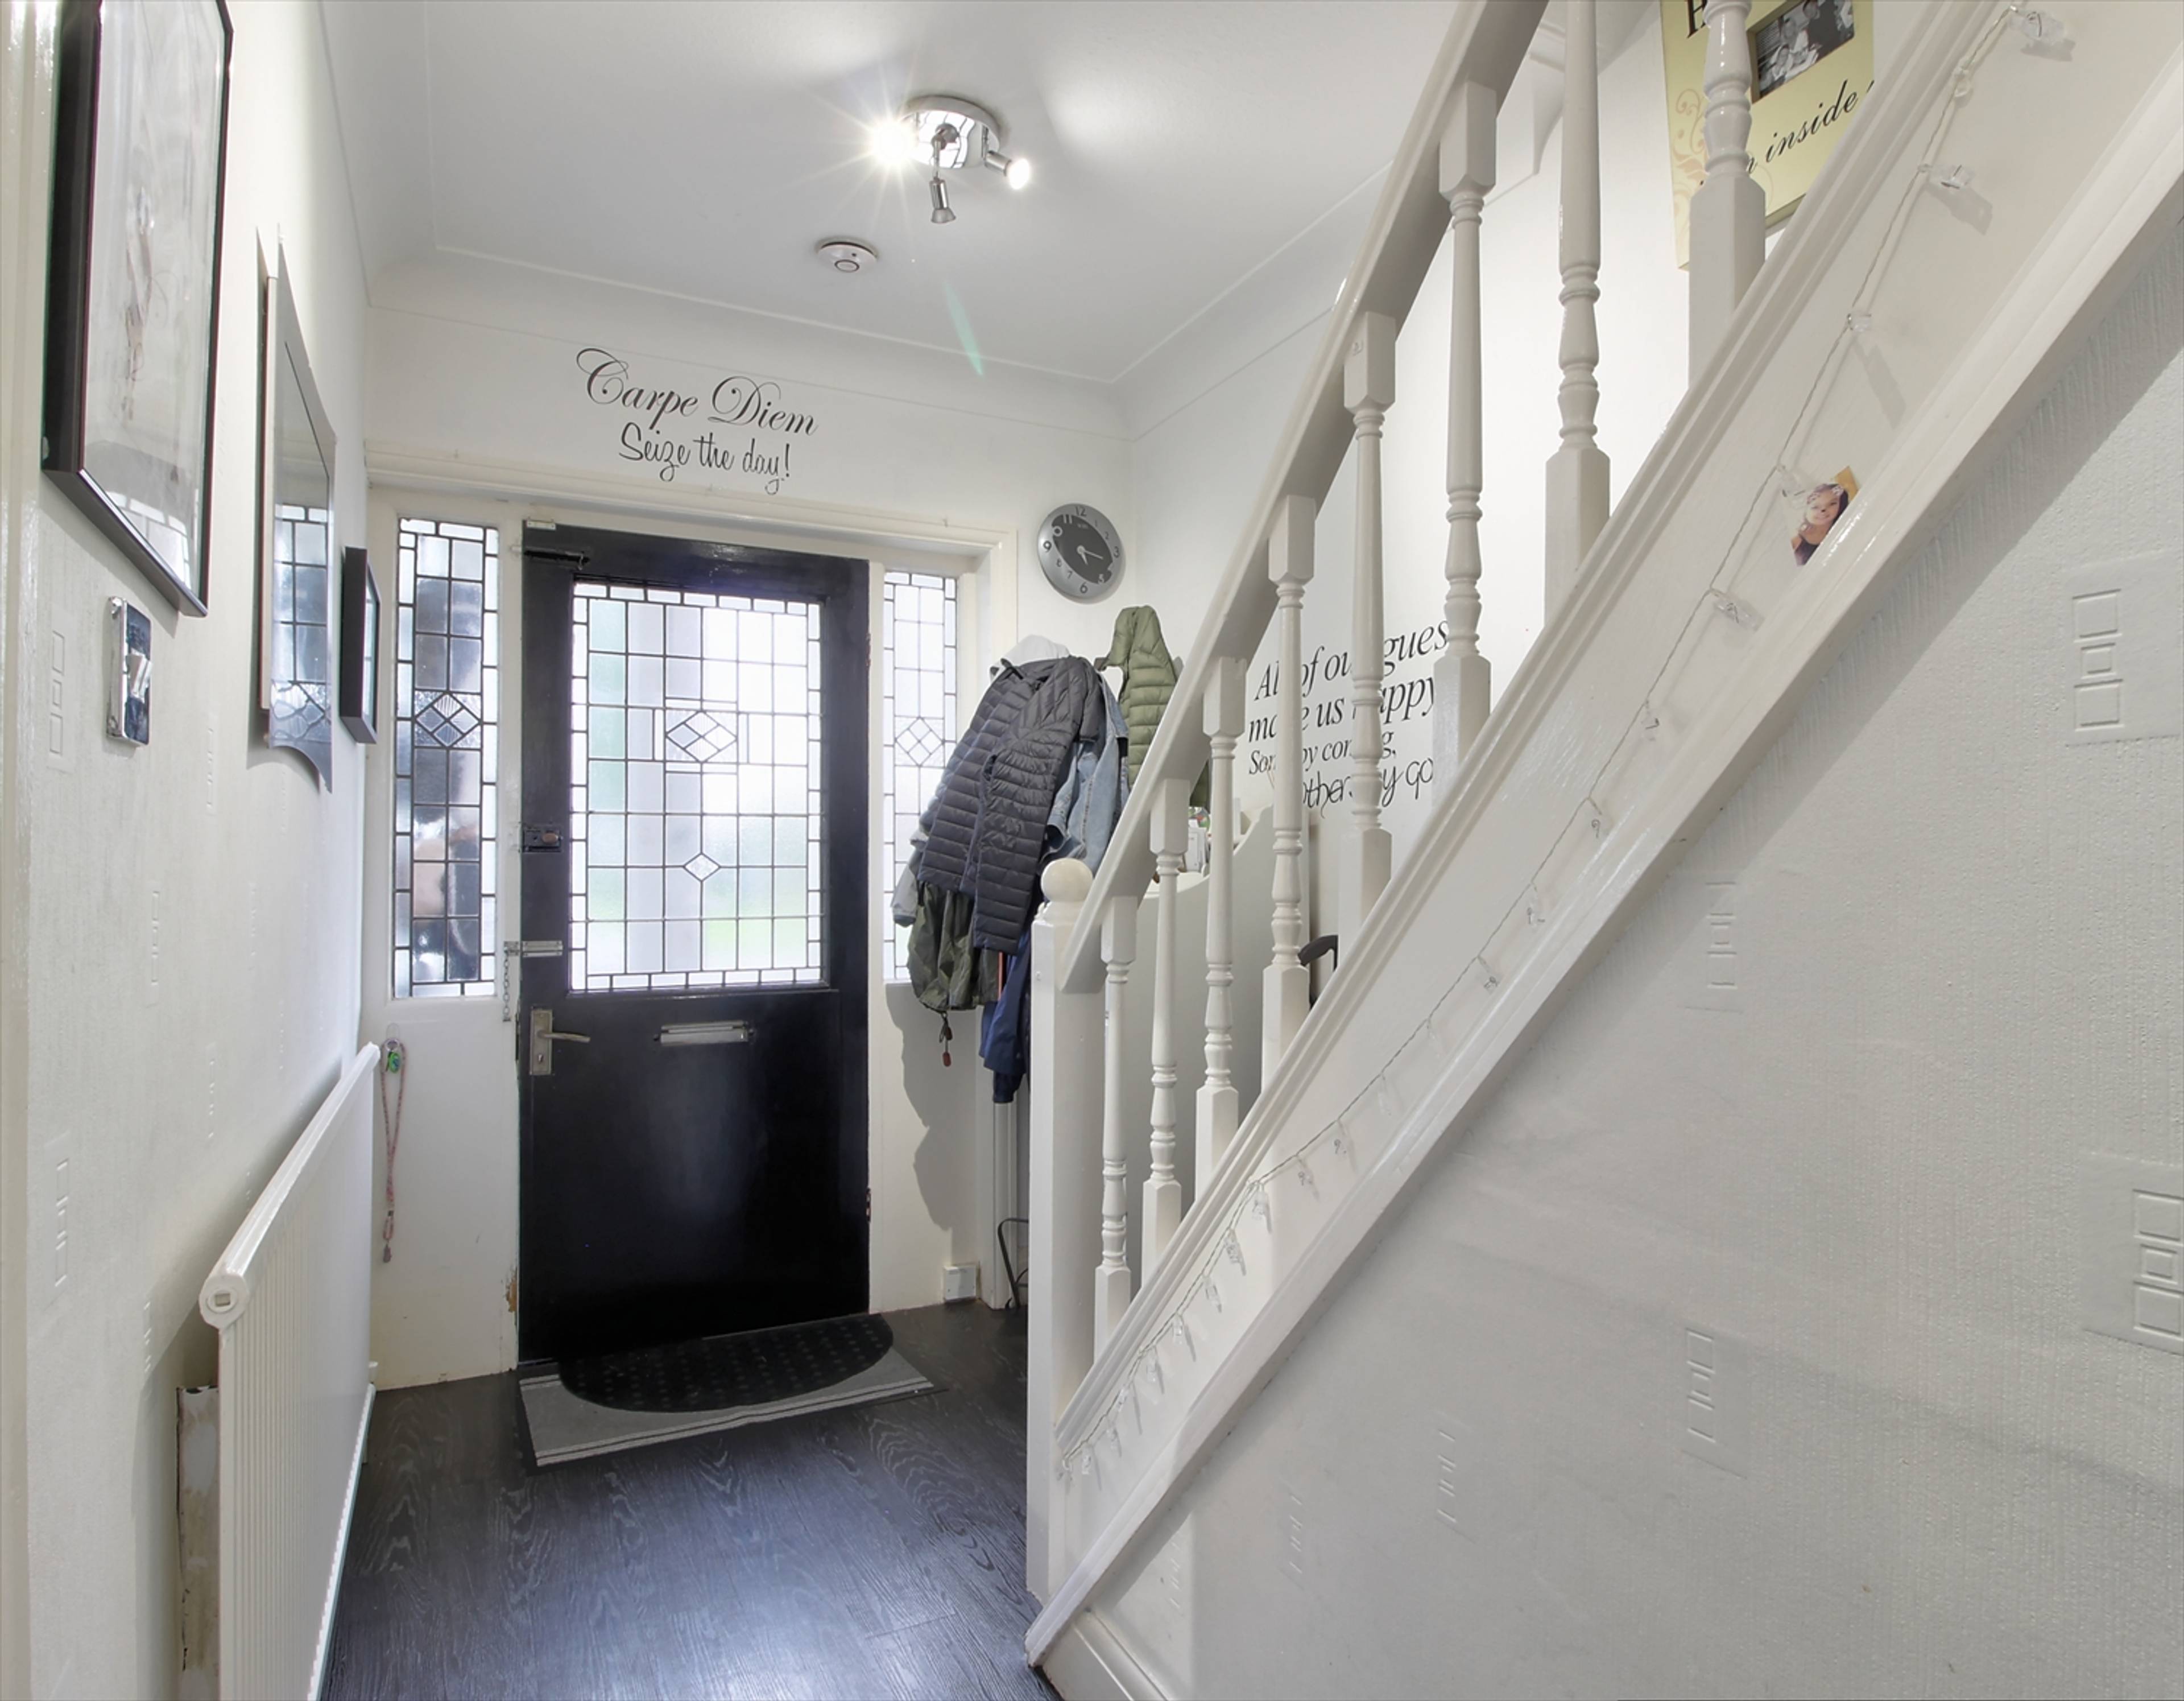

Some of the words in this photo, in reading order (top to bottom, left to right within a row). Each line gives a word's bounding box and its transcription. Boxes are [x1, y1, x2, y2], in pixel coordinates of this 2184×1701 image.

[1766, 79, 1858, 162] inside
[576, 348, 699, 430] Carpe
[708, 375, 818, 436] Diem
[619, 422, 692, 482] Seize
[692, 432, 735, 471] the
[742, 437, 791, 496] day!
[1075, 506, 1087, 517] 12
[1043, 540, 1052, 552] 9
[1114, 546, 1120, 559] 3
[1080, 581, 1089, 594] 6
[1254, 660, 1280, 701] Al
[1324, 651, 1352, 681] ou
[1384, 620, 1449, 677] gues
[1316, 697, 1345, 728] us
